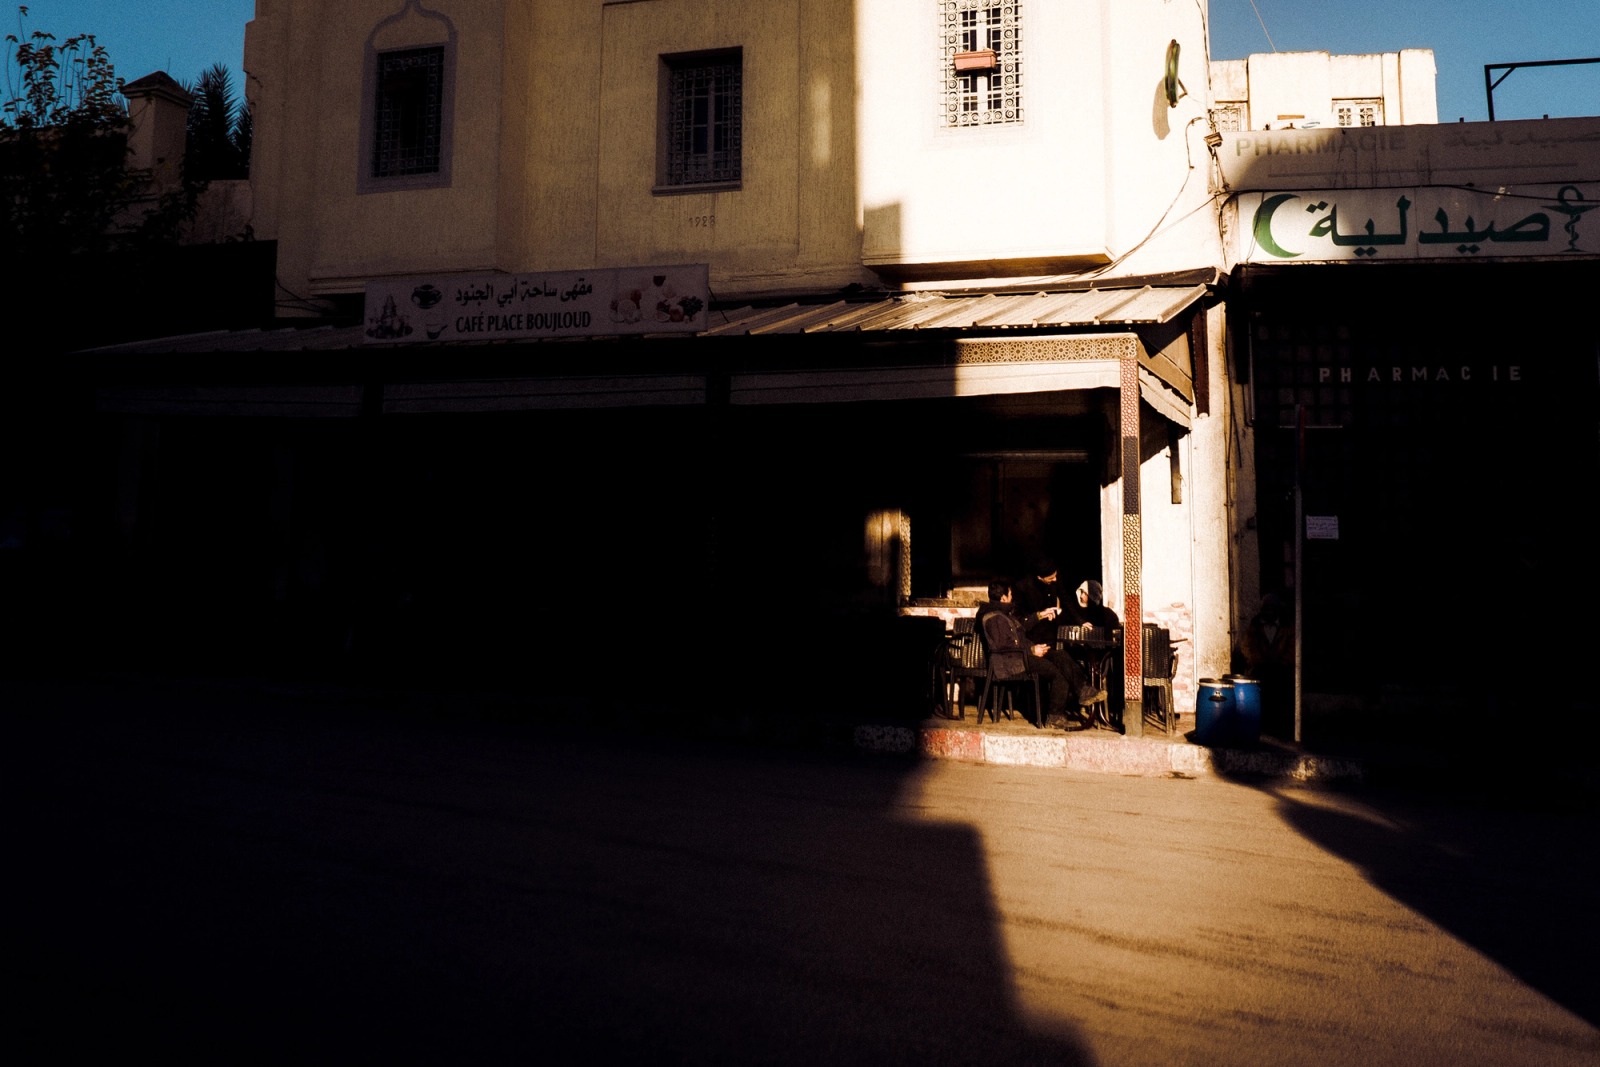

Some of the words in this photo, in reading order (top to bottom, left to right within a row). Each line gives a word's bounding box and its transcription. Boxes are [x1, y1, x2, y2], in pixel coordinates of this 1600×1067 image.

[1236, 131, 1407, 157] PHARMACIE
[1305, 193, 1550, 257] صيدلية
[455, 282, 494, 306] الجنود
[497, 277, 518, 307] أبي
[520, 280, 558, 302] ساحة
[455, 311, 484, 333] CAFÉ
[487, 314, 523, 332] PLACE
[526, 311, 591, 332] BOUJLOUD
[1318, 365, 1522, 383] PHARMACIE
